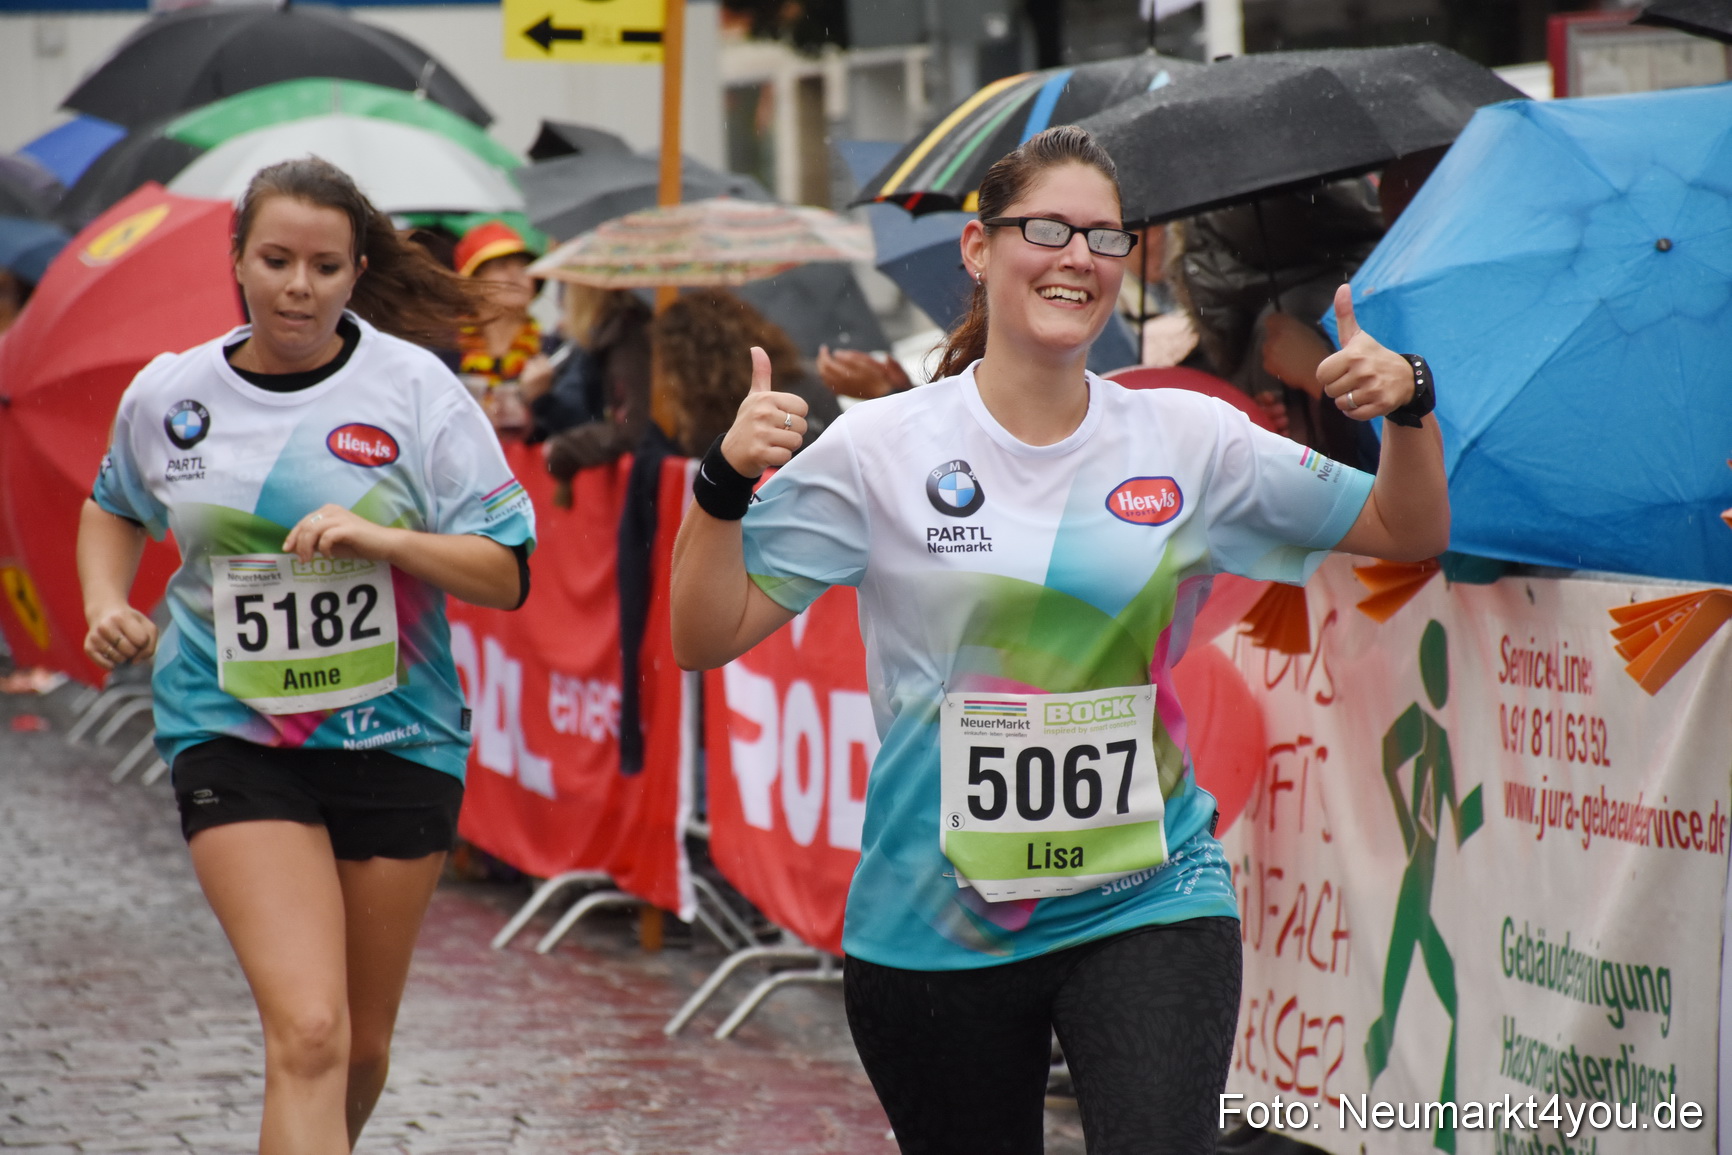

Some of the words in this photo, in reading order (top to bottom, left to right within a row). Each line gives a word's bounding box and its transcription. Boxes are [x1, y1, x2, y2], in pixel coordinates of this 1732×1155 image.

[337, 431, 391, 458] Hervis
[167, 457, 206, 472] PARTL
[165, 471, 205, 482] Neumarkt
[1117, 488, 1175, 512] Hervis
[926, 525, 992, 542] PARTL
[927, 541, 993, 554] Neumarkt
[227, 571, 282, 583] NeuerMarkt
[235, 584, 381, 652] 5182
[283, 667, 341, 690] Anne
[340, 706, 379, 735] 17.
[1044, 695, 1137, 726] BOCK
[960, 717, 1031, 730] NeuerMarkt
[1044, 727, 1077, 736] inspired
[967, 739, 1138, 821] 5067
[1027, 842, 1084, 870] Lisa
